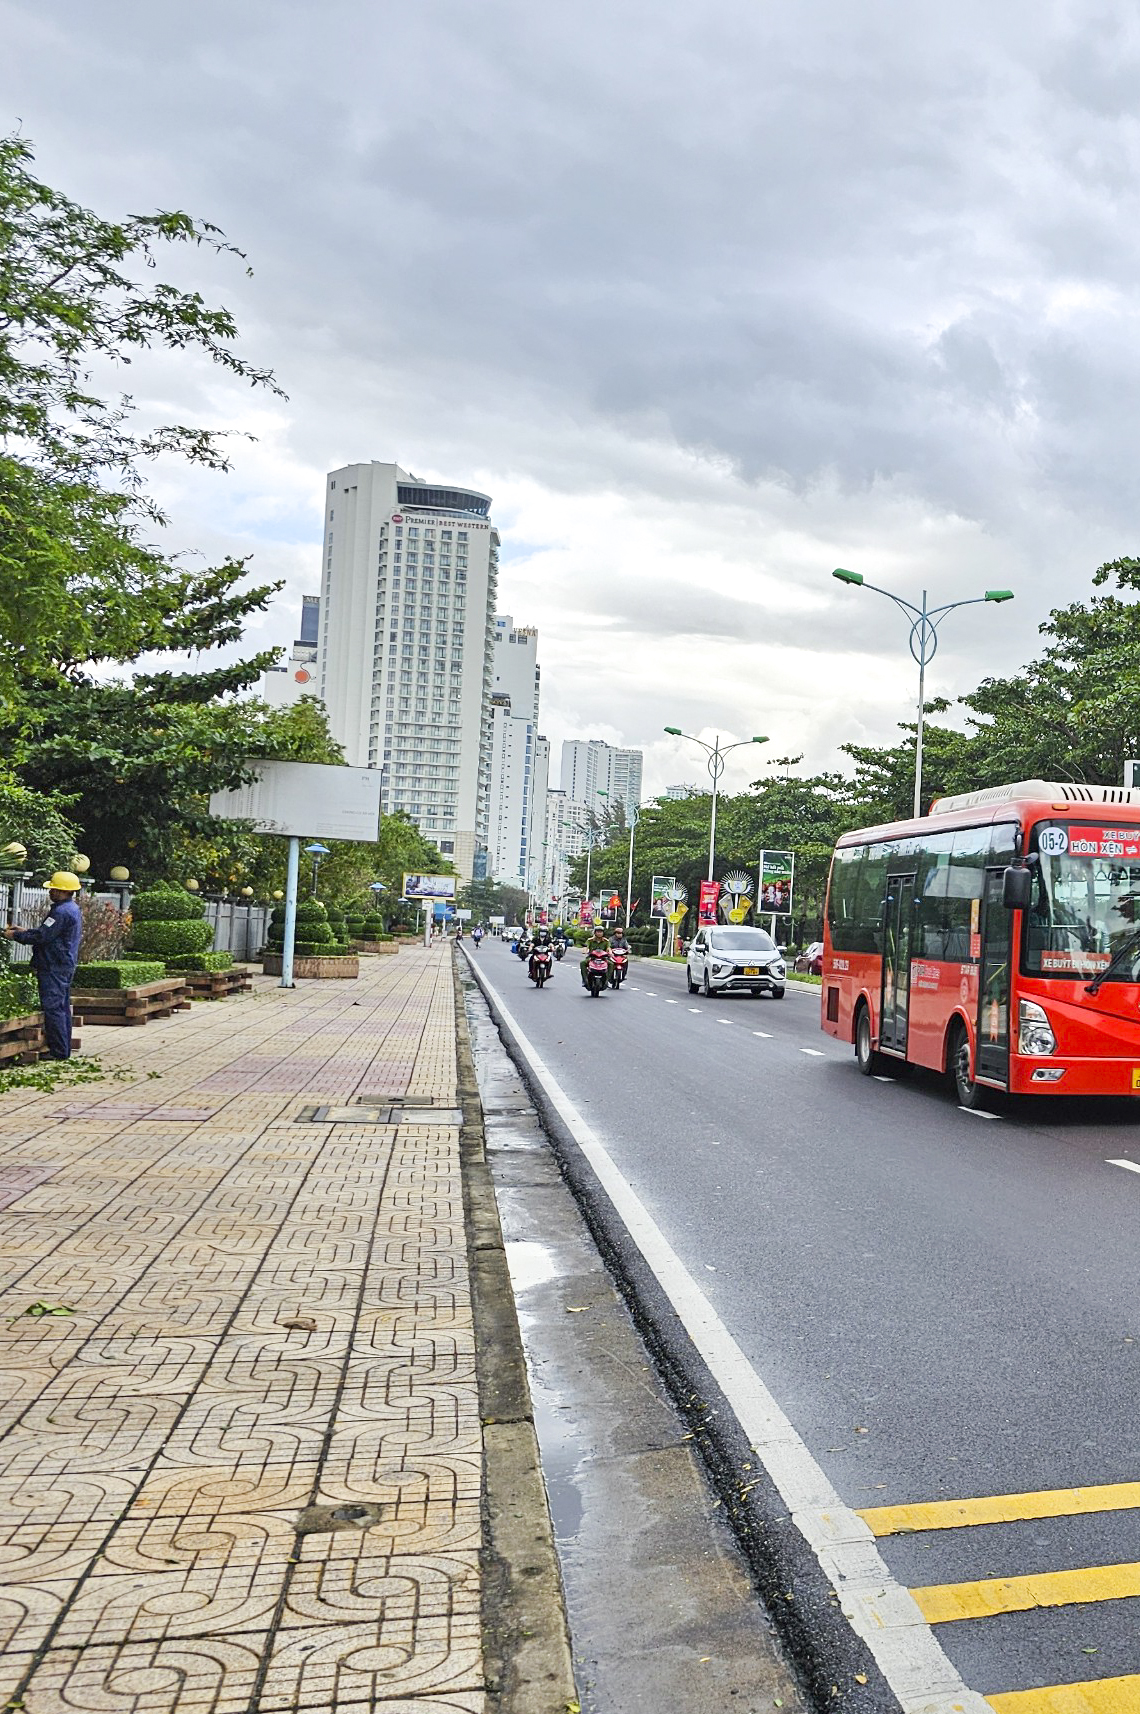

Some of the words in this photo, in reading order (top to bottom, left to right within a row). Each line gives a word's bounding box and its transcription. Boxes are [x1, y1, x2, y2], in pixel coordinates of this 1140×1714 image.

[405, 515, 435, 526] PREMIER
[456, 521, 489, 530] WESTERN
[1041, 832, 1065, 850] 05-2
[1071, 839, 1098, 853] HÒN
